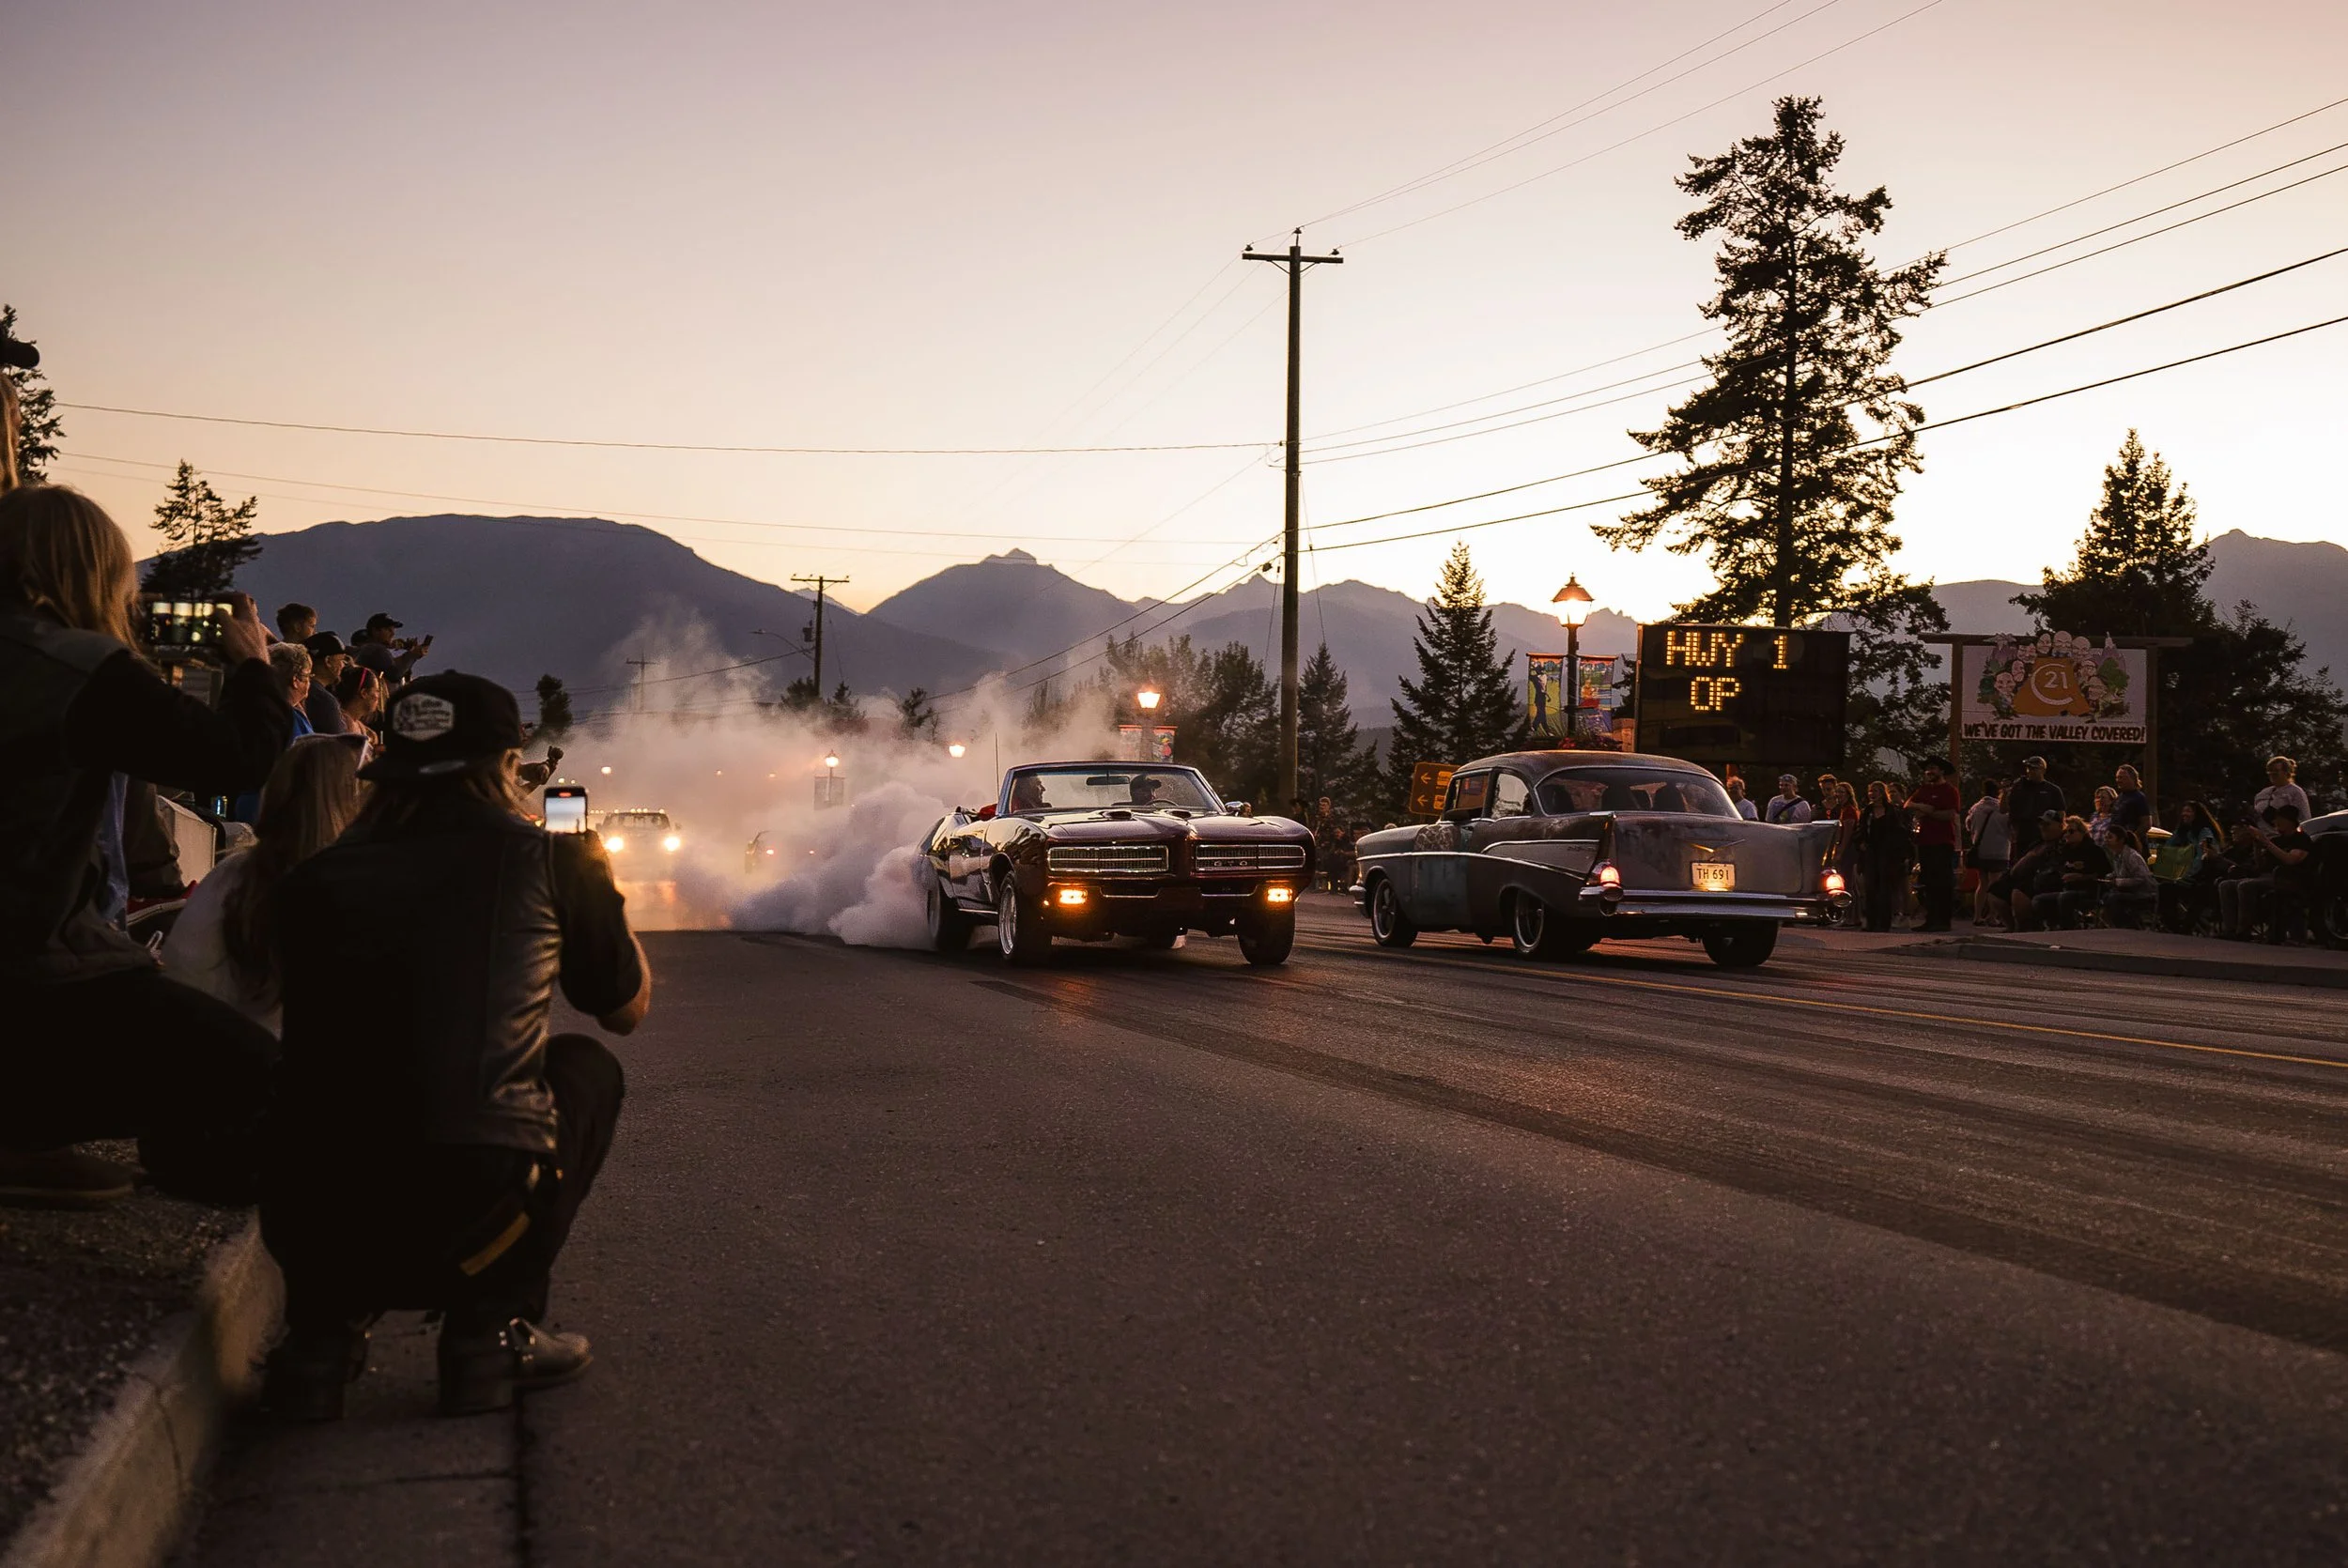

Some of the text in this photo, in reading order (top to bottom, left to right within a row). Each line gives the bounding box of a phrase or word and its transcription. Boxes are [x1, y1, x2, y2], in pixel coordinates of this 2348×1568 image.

[1666, 631, 1788, 669] HWY 1
[2044, 670, 2068, 689] 21
[1691, 676, 1741, 711] OP
[1964, 721, 2146, 742] WE'VE GOT THE VALLEY COVERED!
[1697, 868, 1729, 880] TH 691
